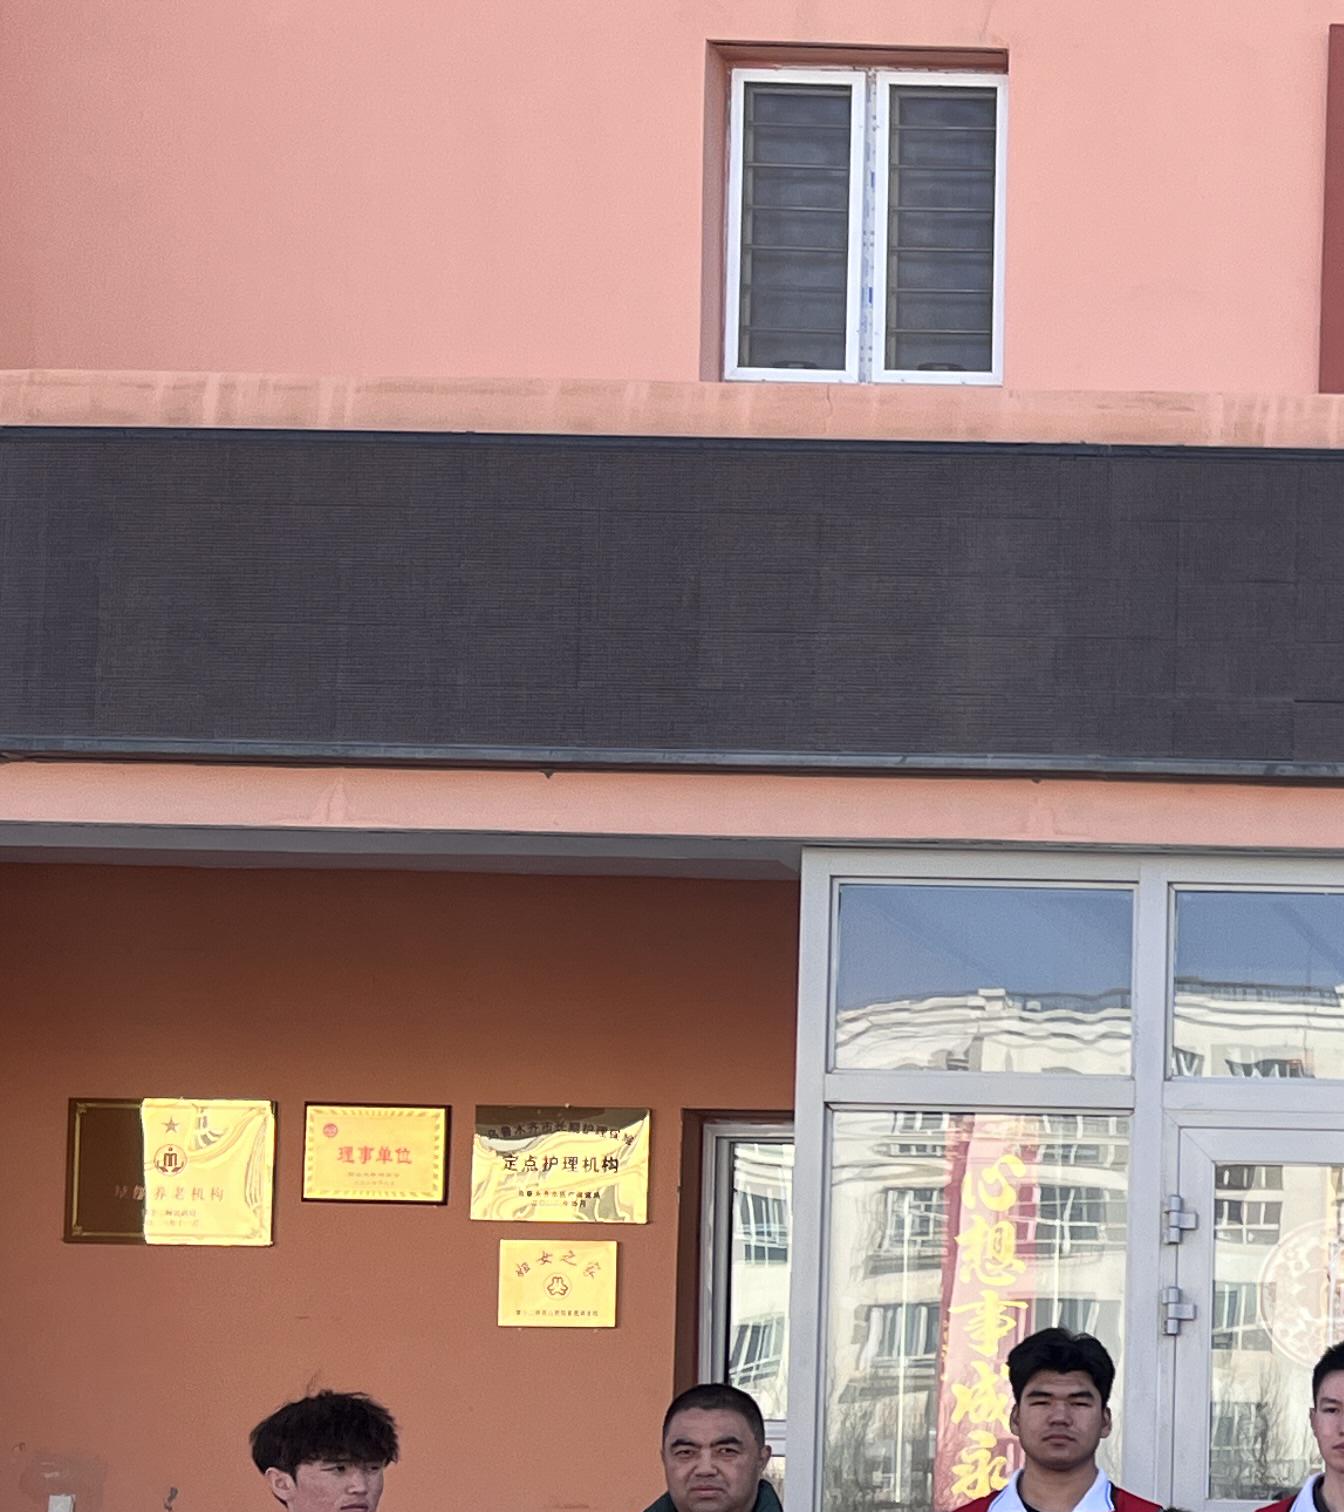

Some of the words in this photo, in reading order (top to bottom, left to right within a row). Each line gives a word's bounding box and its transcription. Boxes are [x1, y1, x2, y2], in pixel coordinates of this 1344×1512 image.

[337, 1145, 413, 1165] 理事单位
[502, 1154, 619, 1174] 定点护理机构
